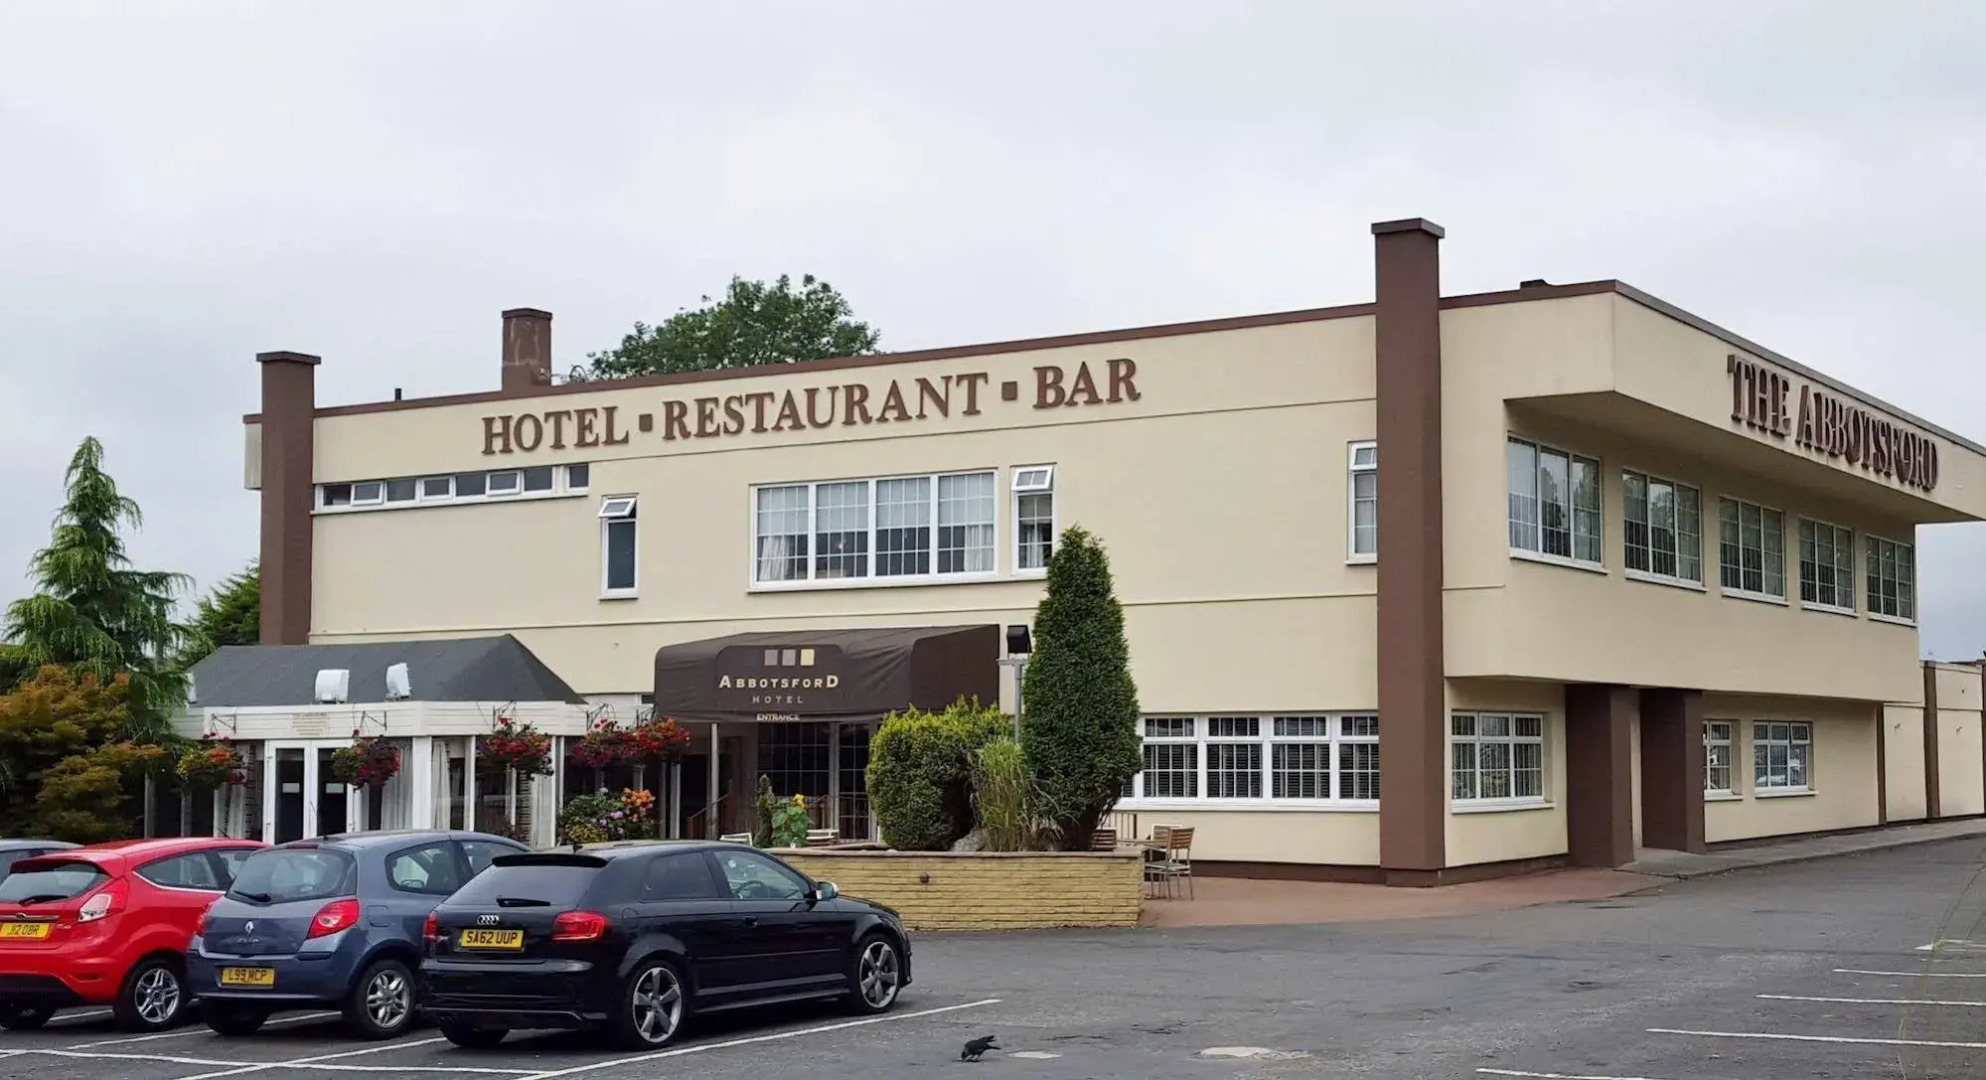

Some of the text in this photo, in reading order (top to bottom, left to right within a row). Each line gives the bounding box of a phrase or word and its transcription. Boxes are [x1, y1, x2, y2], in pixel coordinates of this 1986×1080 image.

[481, 358, 1141, 454] HOTEL RESTAURANT BAR
[1727, 354, 1939, 491] THE ABBOTSFORD
[719, 675, 839, 688] ABBOTSFORD
[752, 696, 804, 704] HOTEL
[756, 713, 801, 721] ENTRANCE
[465, 931, 518, 944] SA62 UUP
[228, 969, 246, 981] L99
